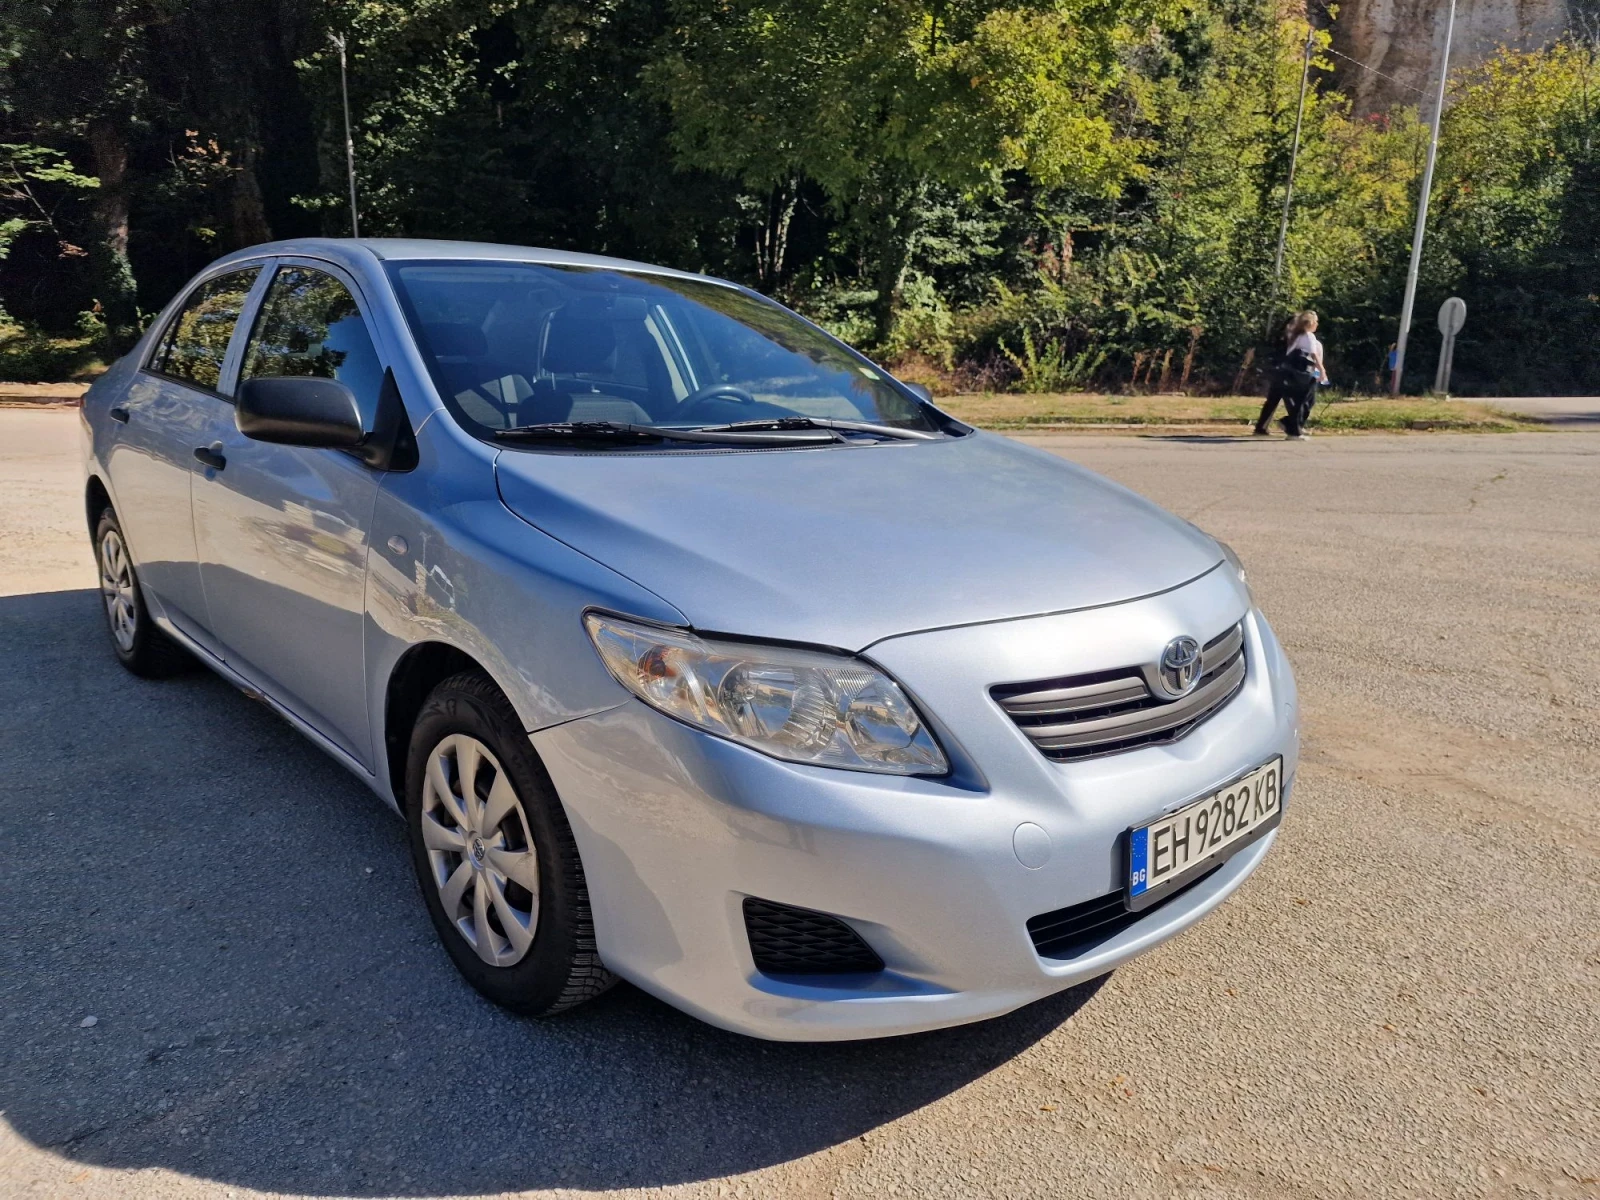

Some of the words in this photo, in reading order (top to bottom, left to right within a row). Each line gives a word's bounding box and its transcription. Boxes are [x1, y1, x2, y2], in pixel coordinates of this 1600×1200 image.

[1152, 816, 1191, 879] EH
[1196, 785, 1251, 855] 9282
[1254, 768, 1277, 822] KB
[1132, 868, 1146, 886] BG
